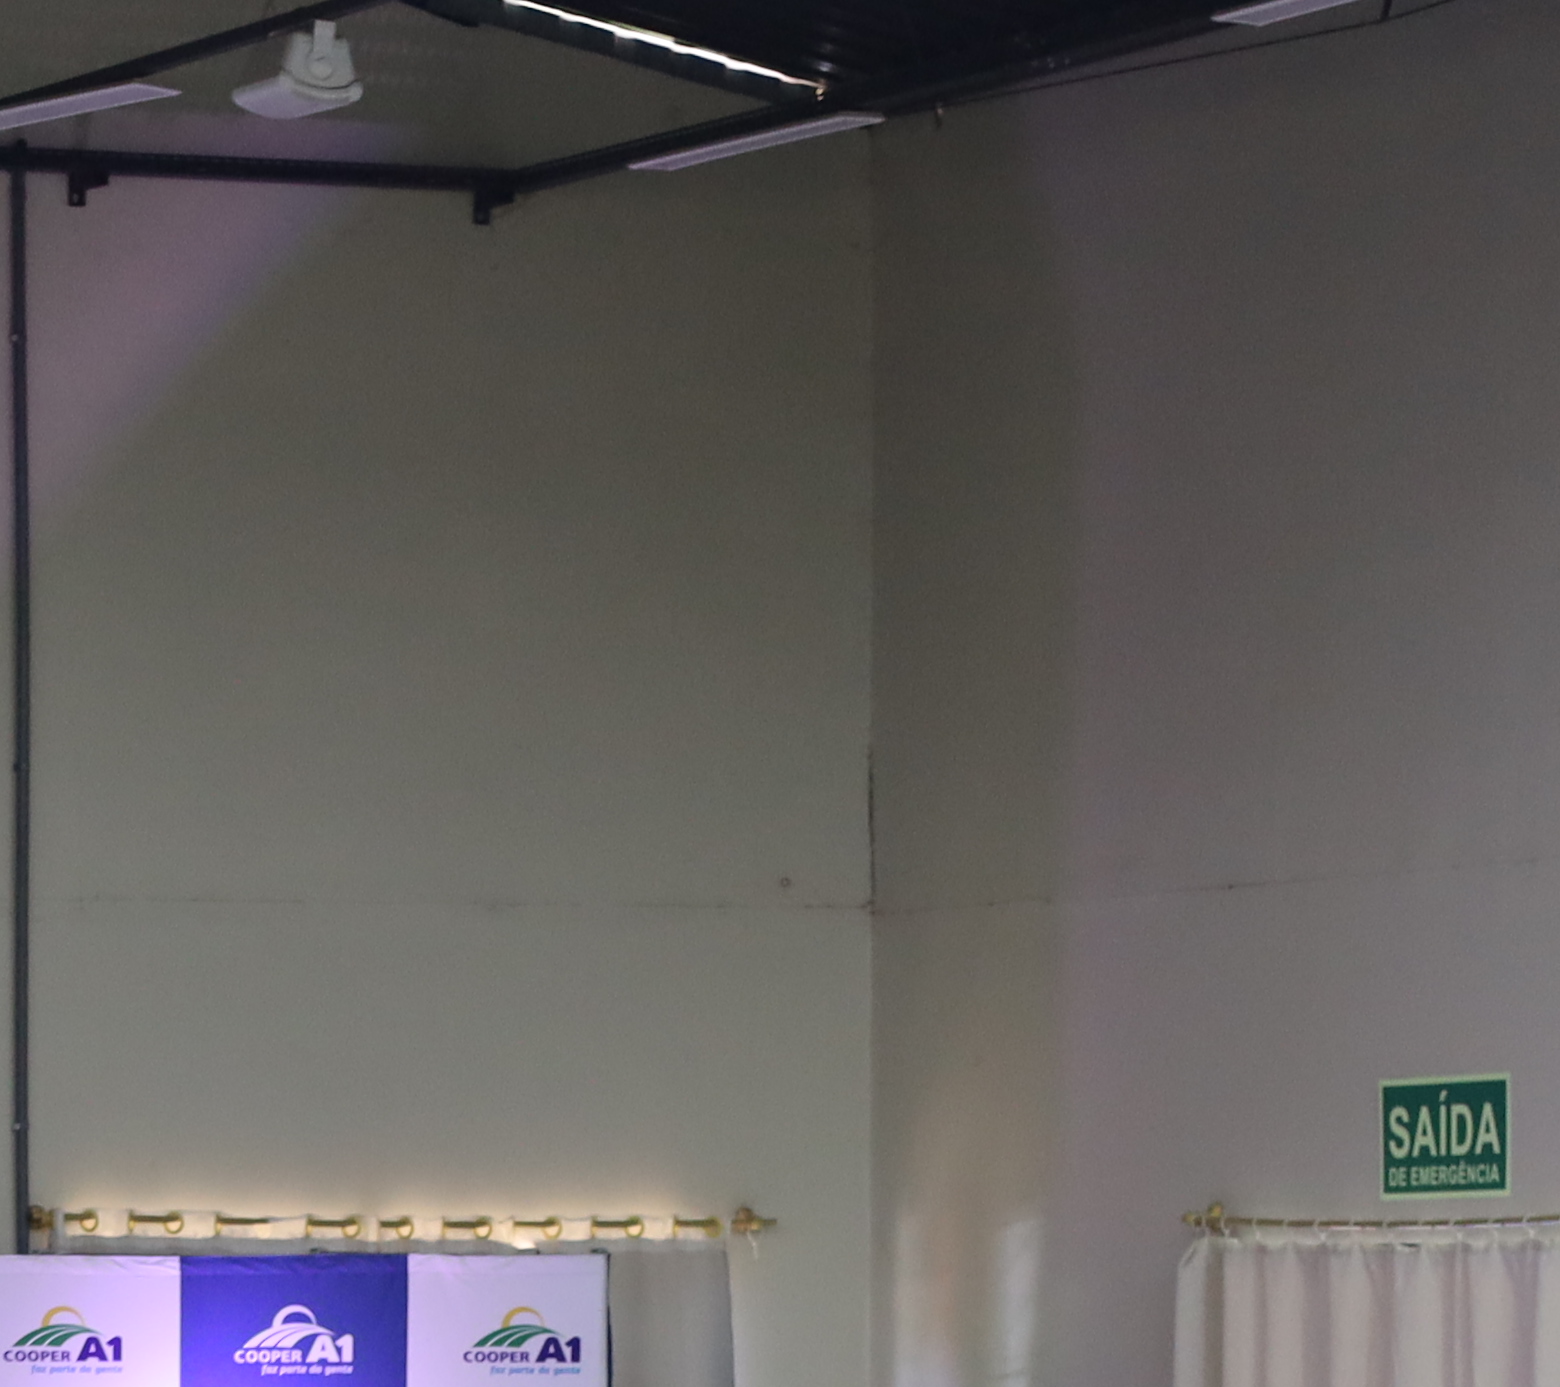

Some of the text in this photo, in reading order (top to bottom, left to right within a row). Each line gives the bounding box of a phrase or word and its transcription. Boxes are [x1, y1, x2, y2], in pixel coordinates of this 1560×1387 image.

[1389, 1090, 1501, 1159] SAÍDA
[1389, 1159, 1500, 1186] DE EMERGÊNCIA
[3, 1336, 122, 1362] COOPER A1
[234, 1334, 354, 1363] COOPER A1
[463, 1337, 581, 1363] COOPER A1
